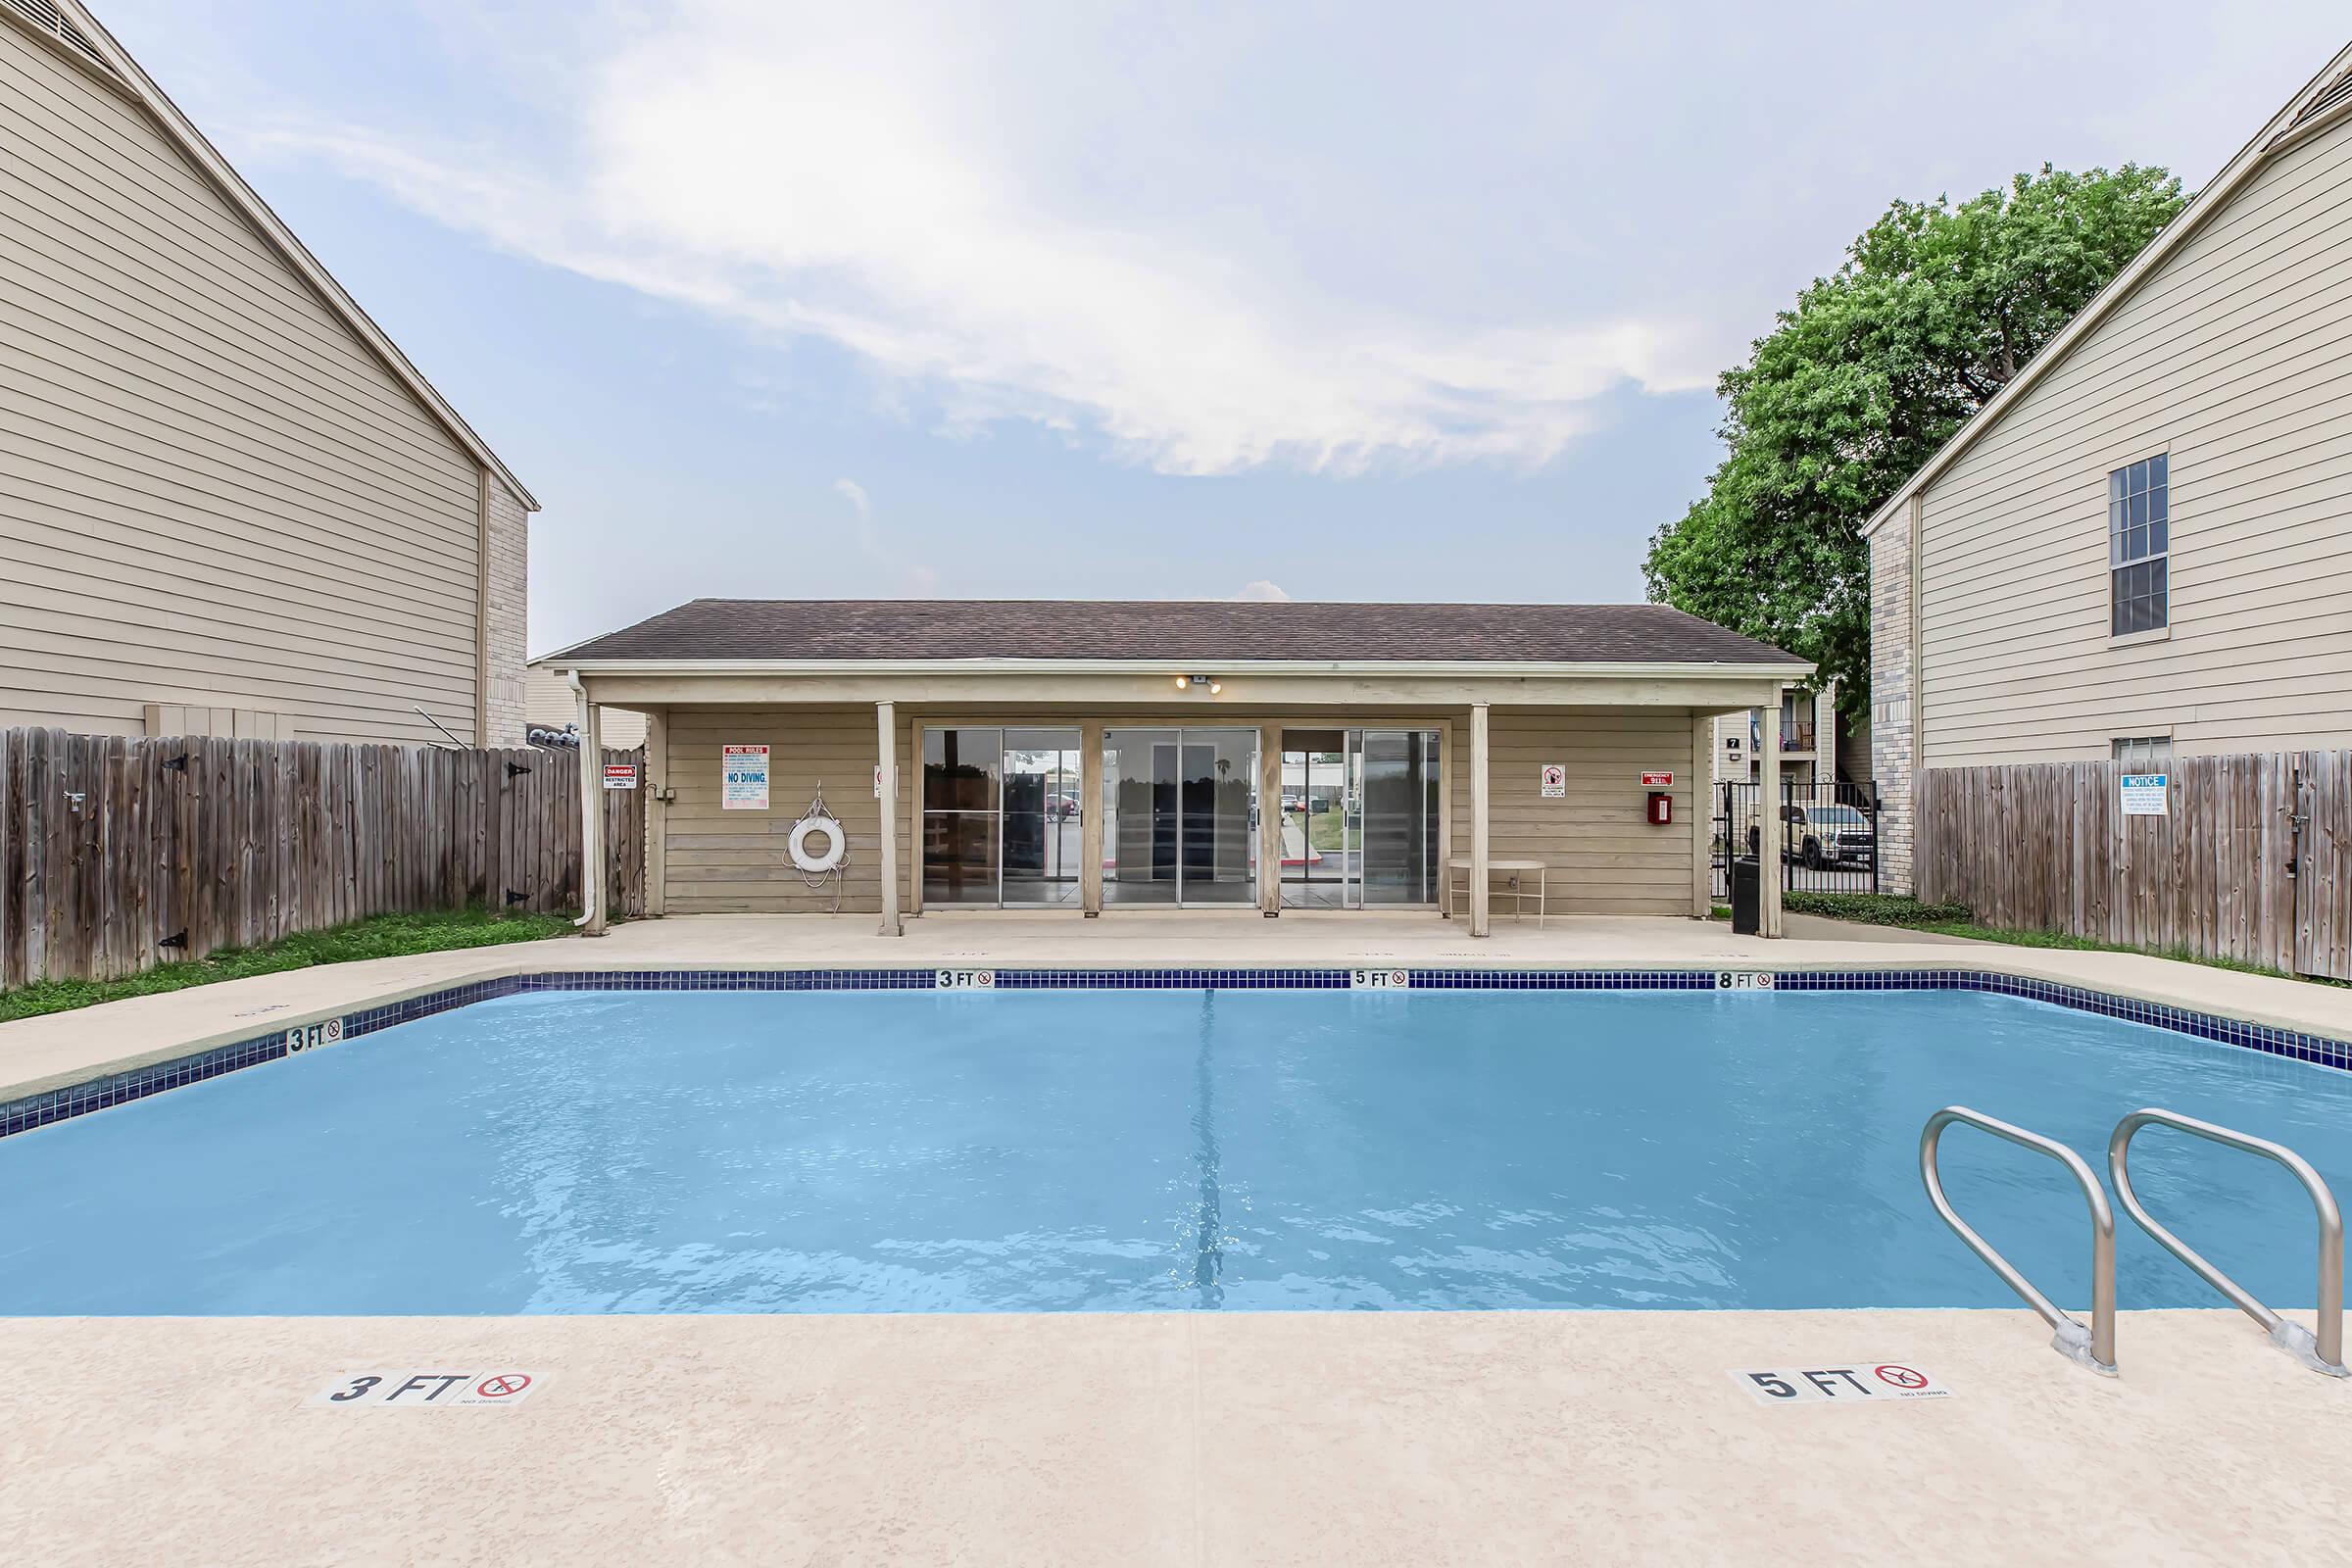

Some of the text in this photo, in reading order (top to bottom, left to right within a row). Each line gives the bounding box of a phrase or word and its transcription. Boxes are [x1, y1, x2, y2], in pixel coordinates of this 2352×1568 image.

[1730, 739, 1737, 748] 7
[728, 772, 739, 783] NO
[2129, 776, 2160, 787] NOTICE
[940, 970, 973, 988] 3 FT
[1355, 970, 1388, 987] 5 FT
[1719, 972, 1753, 989] 8 FT
[290, 1028, 304, 1053] 3
[329, 1375, 471, 1401] 3 FT
[1747, 1370, 1872, 1397] 5 FT
